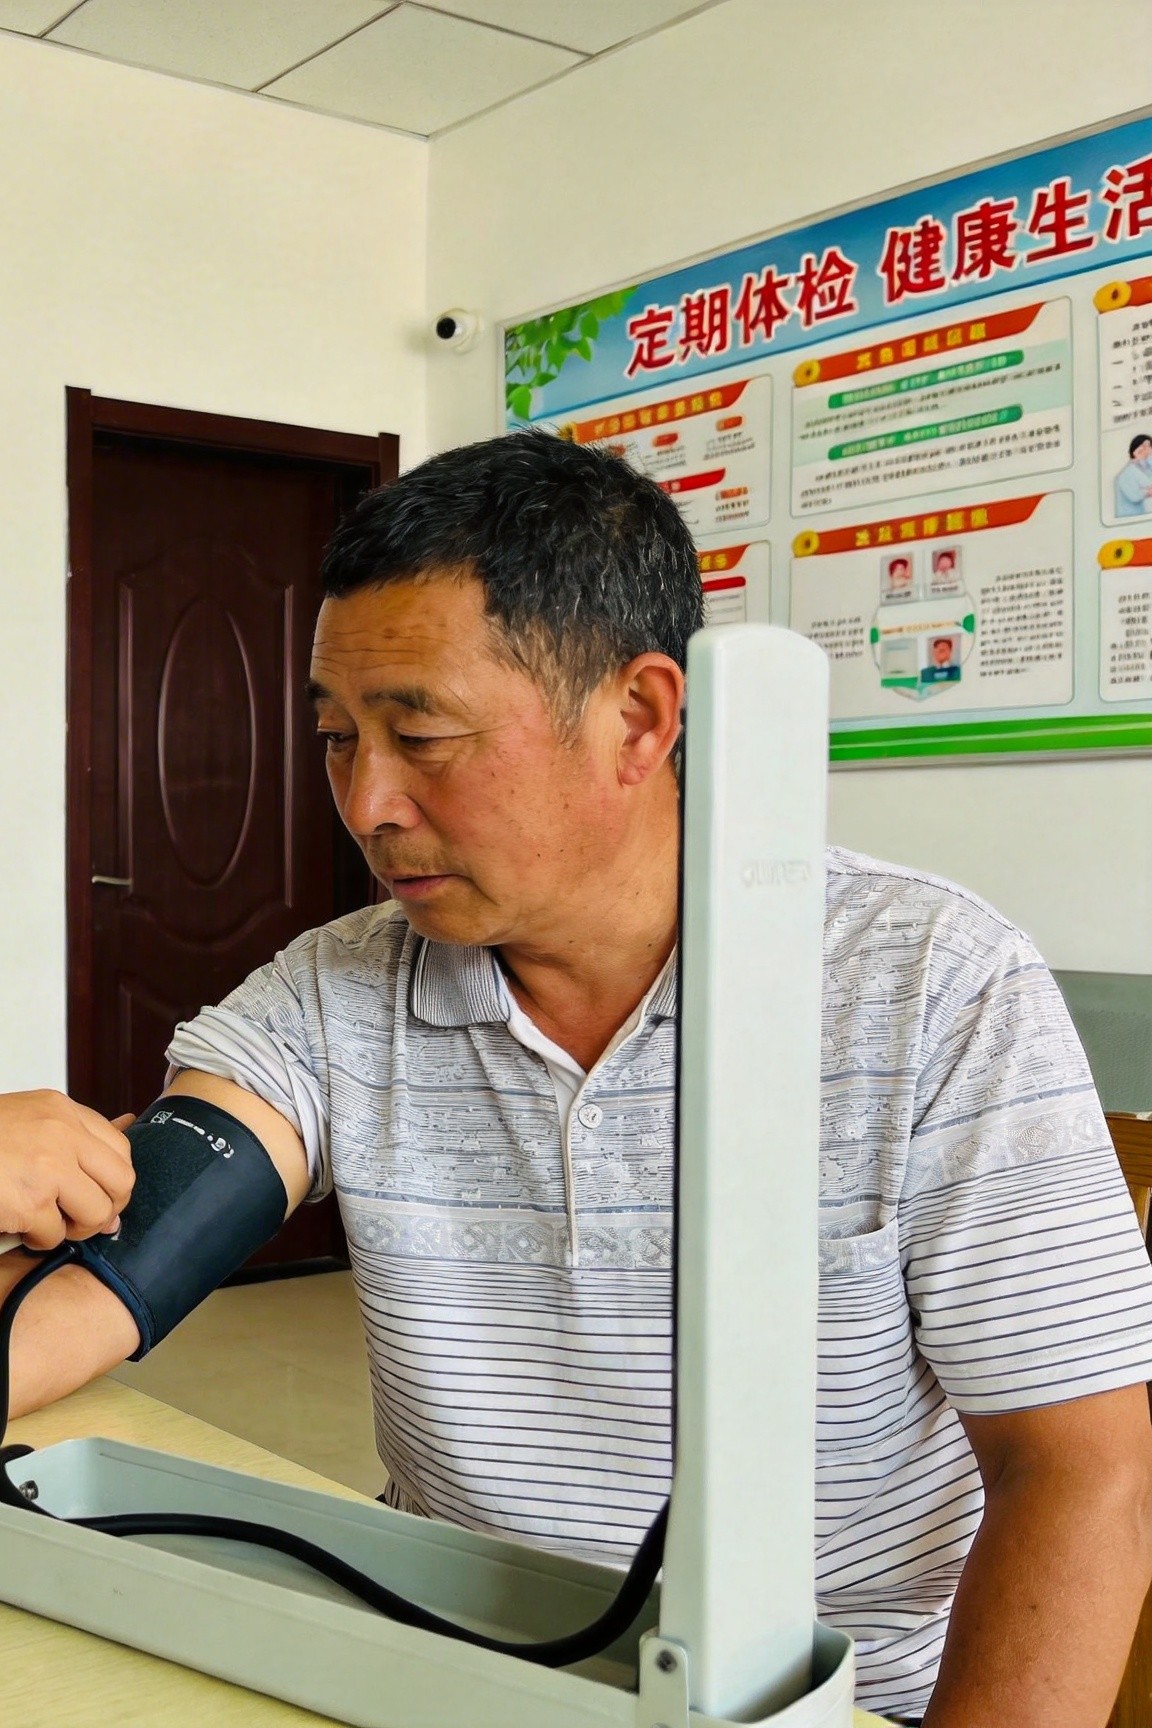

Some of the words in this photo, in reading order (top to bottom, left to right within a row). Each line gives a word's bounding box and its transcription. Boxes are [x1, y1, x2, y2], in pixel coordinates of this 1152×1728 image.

[625, 249, 857, 376] 定期体检
[880, 157, 1152, 303] 健康生活
